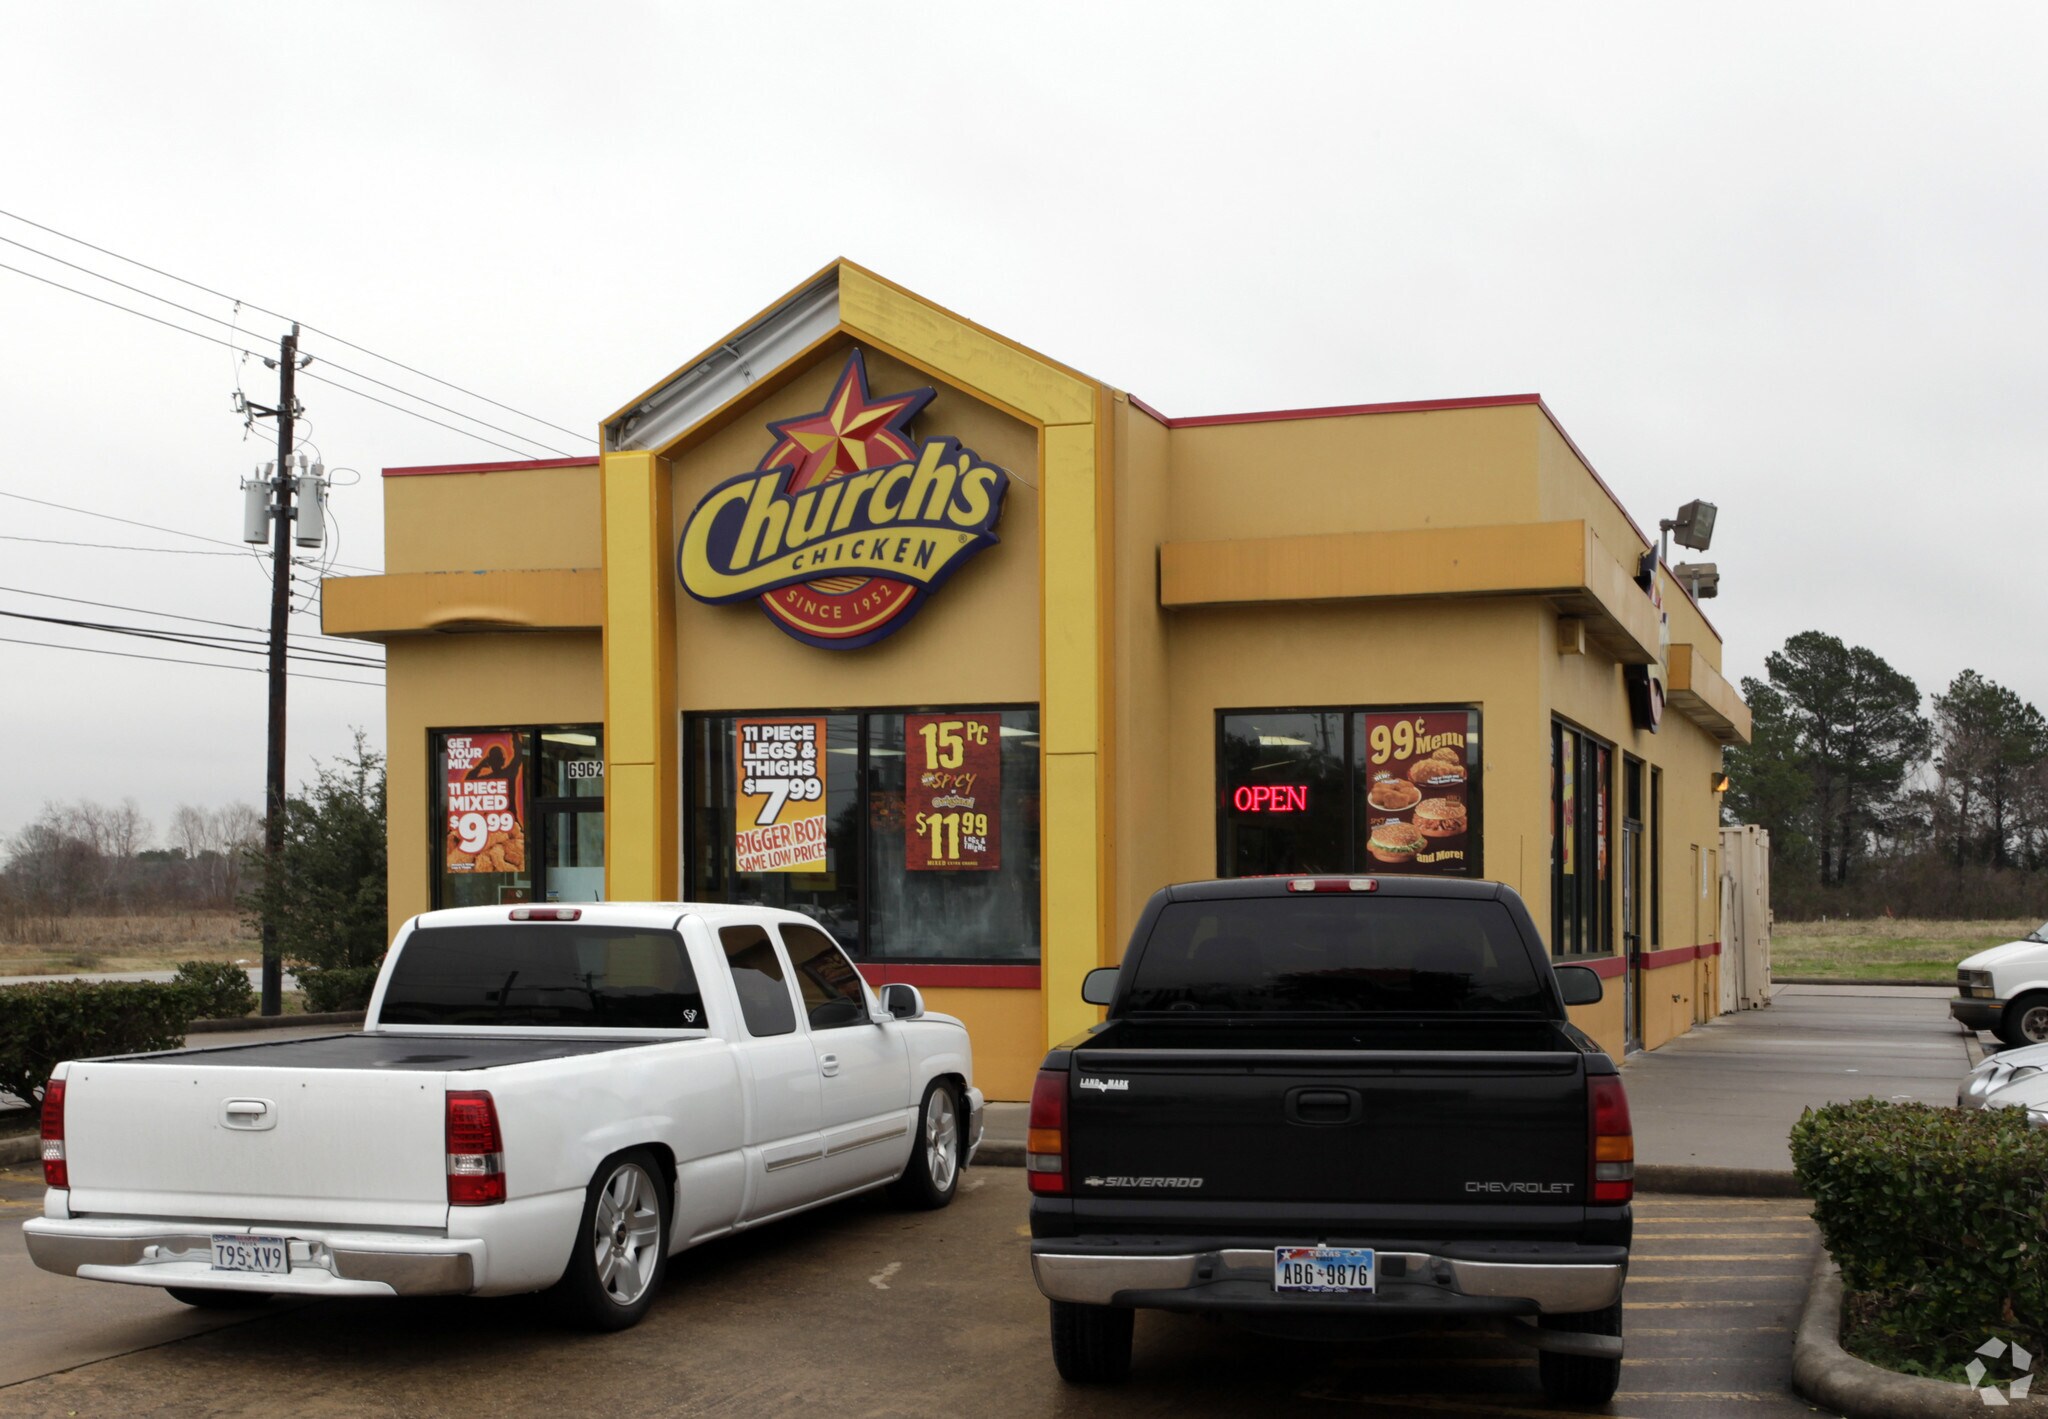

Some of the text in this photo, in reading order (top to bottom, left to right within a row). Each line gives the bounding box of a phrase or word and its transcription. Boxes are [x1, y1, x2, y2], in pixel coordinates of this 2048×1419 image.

[681, 442, 997, 597] Church's
[792, 537, 936, 570] CHICKEN
[786, 585, 892, 619] SINCE 1952
[743, 725, 815, 741] 11 PIECE
[447, 738, 472, 749] GET
[744, 742, 816, 759] LEGS &
[919, 721, 989, 769] 15 PC
[1416, 731, 1464, 755] Menu
[448, 748, 482, 759] YOUR
[448, 759, 473, 770] MIX.
[568, 761, 603, 778] 6962
[744, 761, 815, 776] THIGHS
[448, 781, 507, 795] 11 PIECE
[449, 795, 508, 811] MIXED
[1234, 786, 1307, 812] OPEN
[736, 817, 826, 856] BIGGER BOX
[739, 853, 767, 872] SAME
[769, 850, 791, 867] LOW
[1416, 850, 1464, 863] and More!
[1080, 1078, 1129, 1087] LAND MARK
[1105, 1176, 1203, 1188] SILVERADO
[1465, 1182, 1574, 1193] CHEVROLET
[1284, 1263, 1367, 1286] AB6 9876
